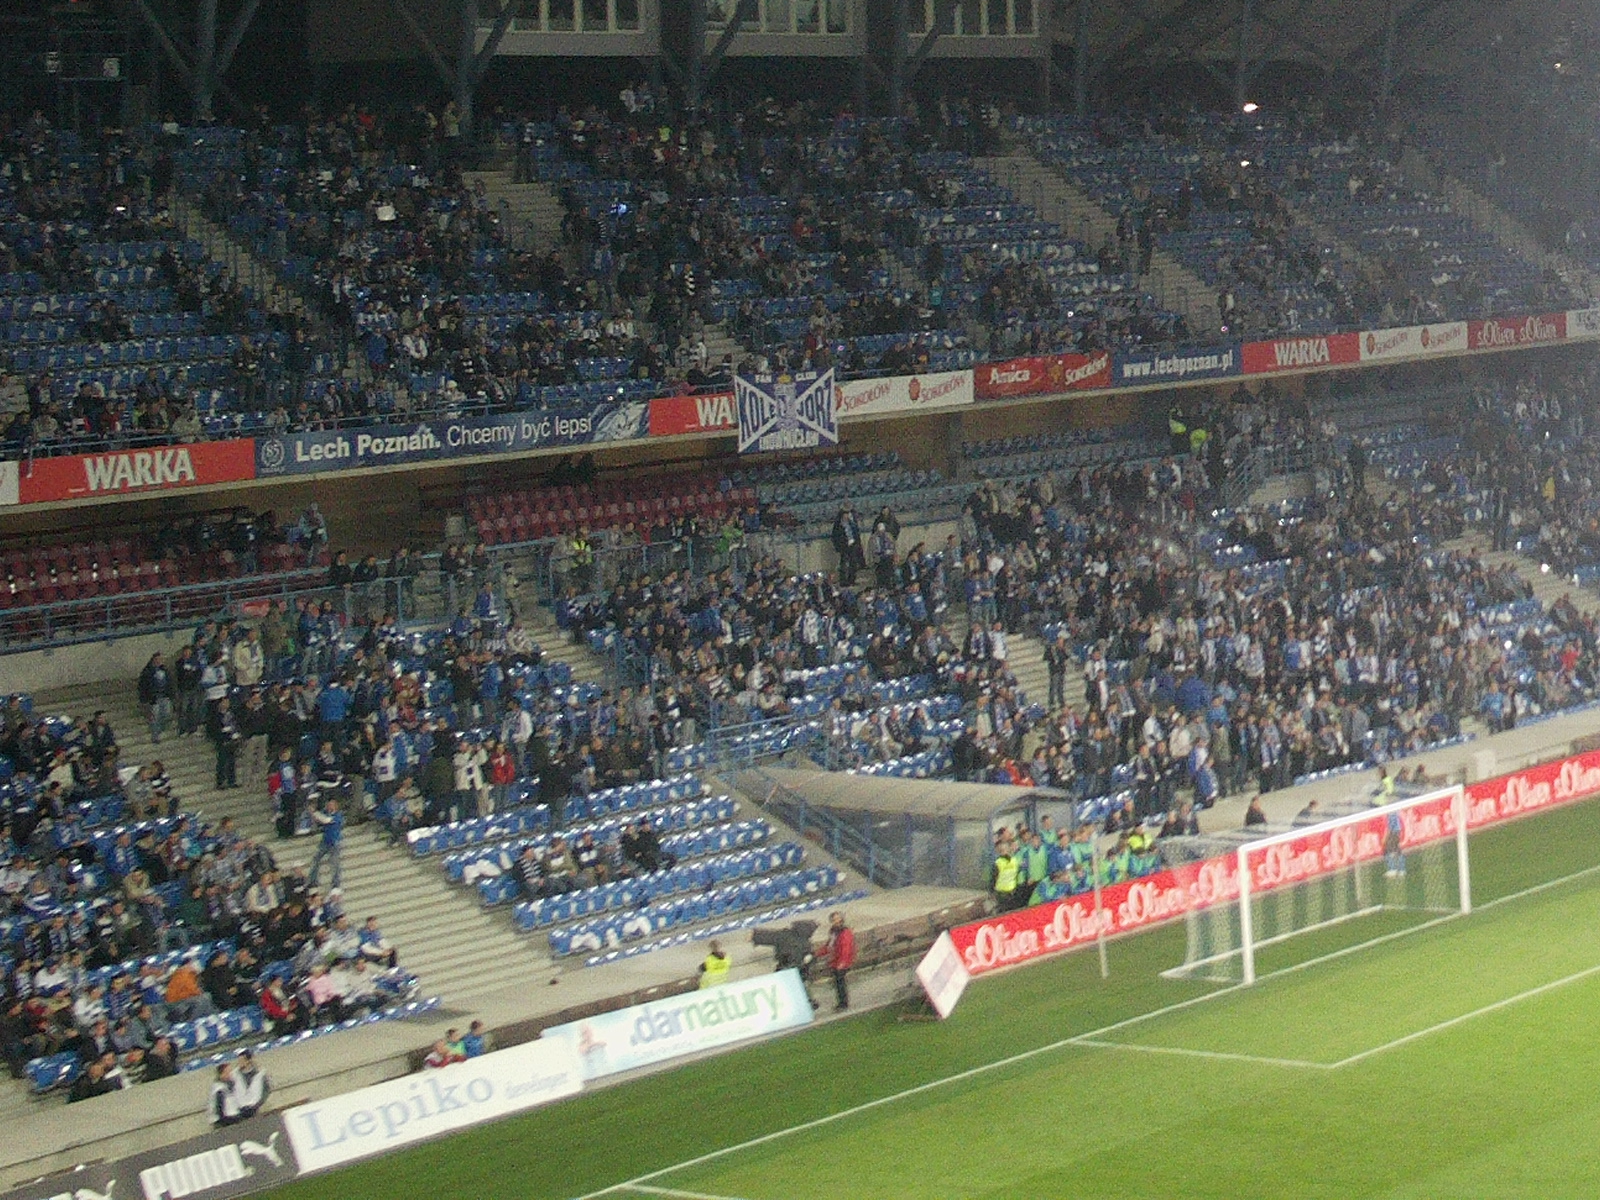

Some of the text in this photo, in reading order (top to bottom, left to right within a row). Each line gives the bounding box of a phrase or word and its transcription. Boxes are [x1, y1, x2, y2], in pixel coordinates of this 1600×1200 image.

[1122, 350, 1233, 378] www.lechpoznan.pl
[1274, 337, 1330, 366] WARKA
[295, 436, 351, 462] Lech
[447, 421, 517, 450] Chcemy
[521, 415, 551, 443] być
[554, 412, 593, 440] lepsi
[83, 448, 197, 492] WARKA
[300, 1076, 494, 1151] Lepiko
